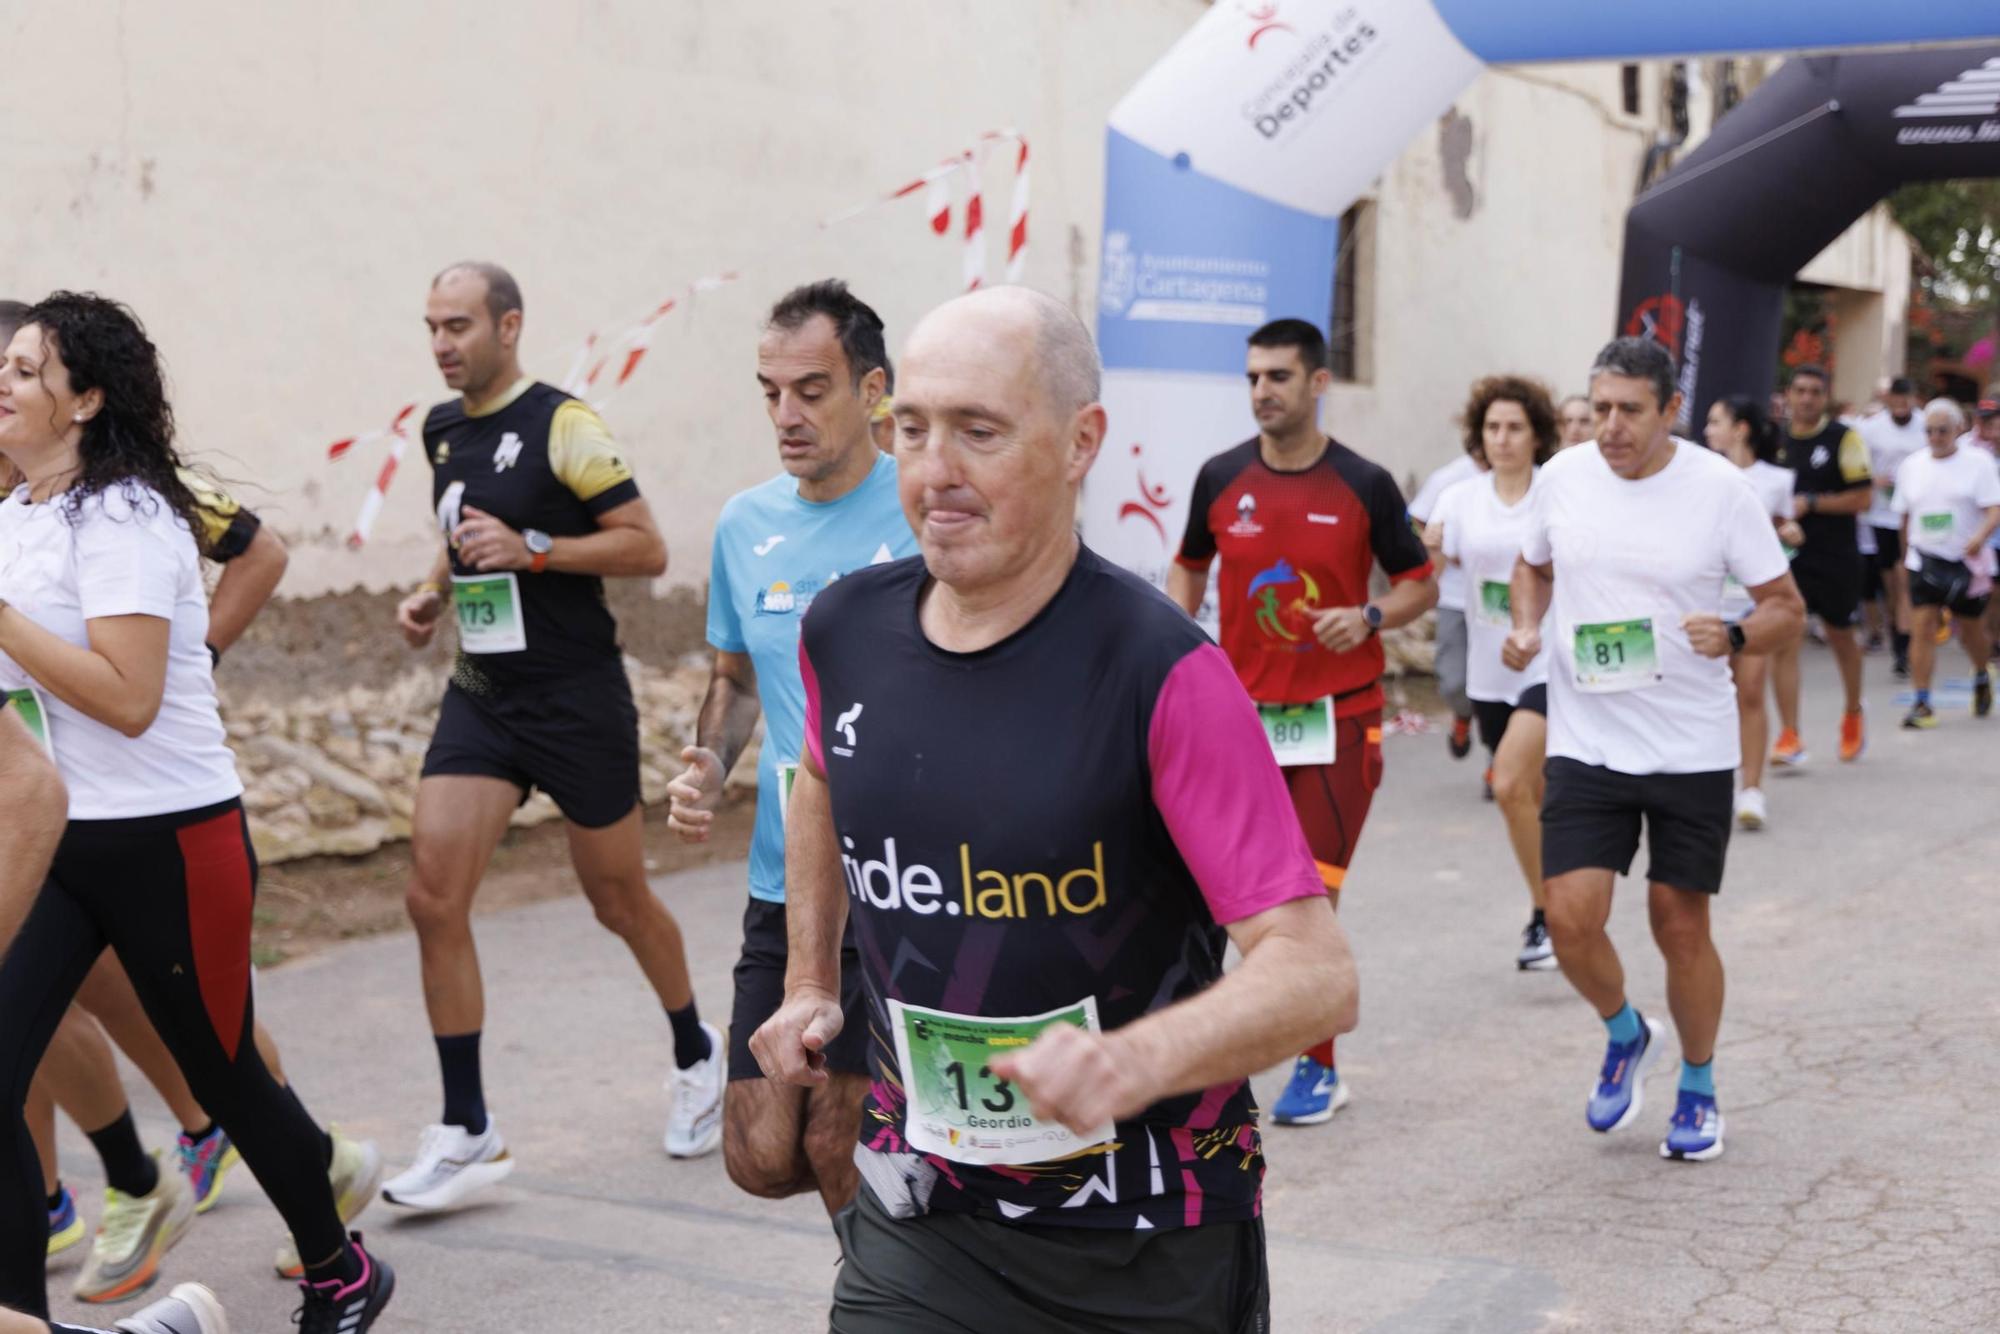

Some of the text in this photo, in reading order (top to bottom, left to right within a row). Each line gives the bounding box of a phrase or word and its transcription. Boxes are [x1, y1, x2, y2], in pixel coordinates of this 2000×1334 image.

[1254, 21, 1377, 139] Deportes
[1136, 273, 1268, 303] Cartagena
[1595, 641, 1624, 666] 81
[1273, 721, 1303, 743] 80
[841, 836, 1107, 918] ride.land
[967, 1115, 1032, 1129] Geordio
